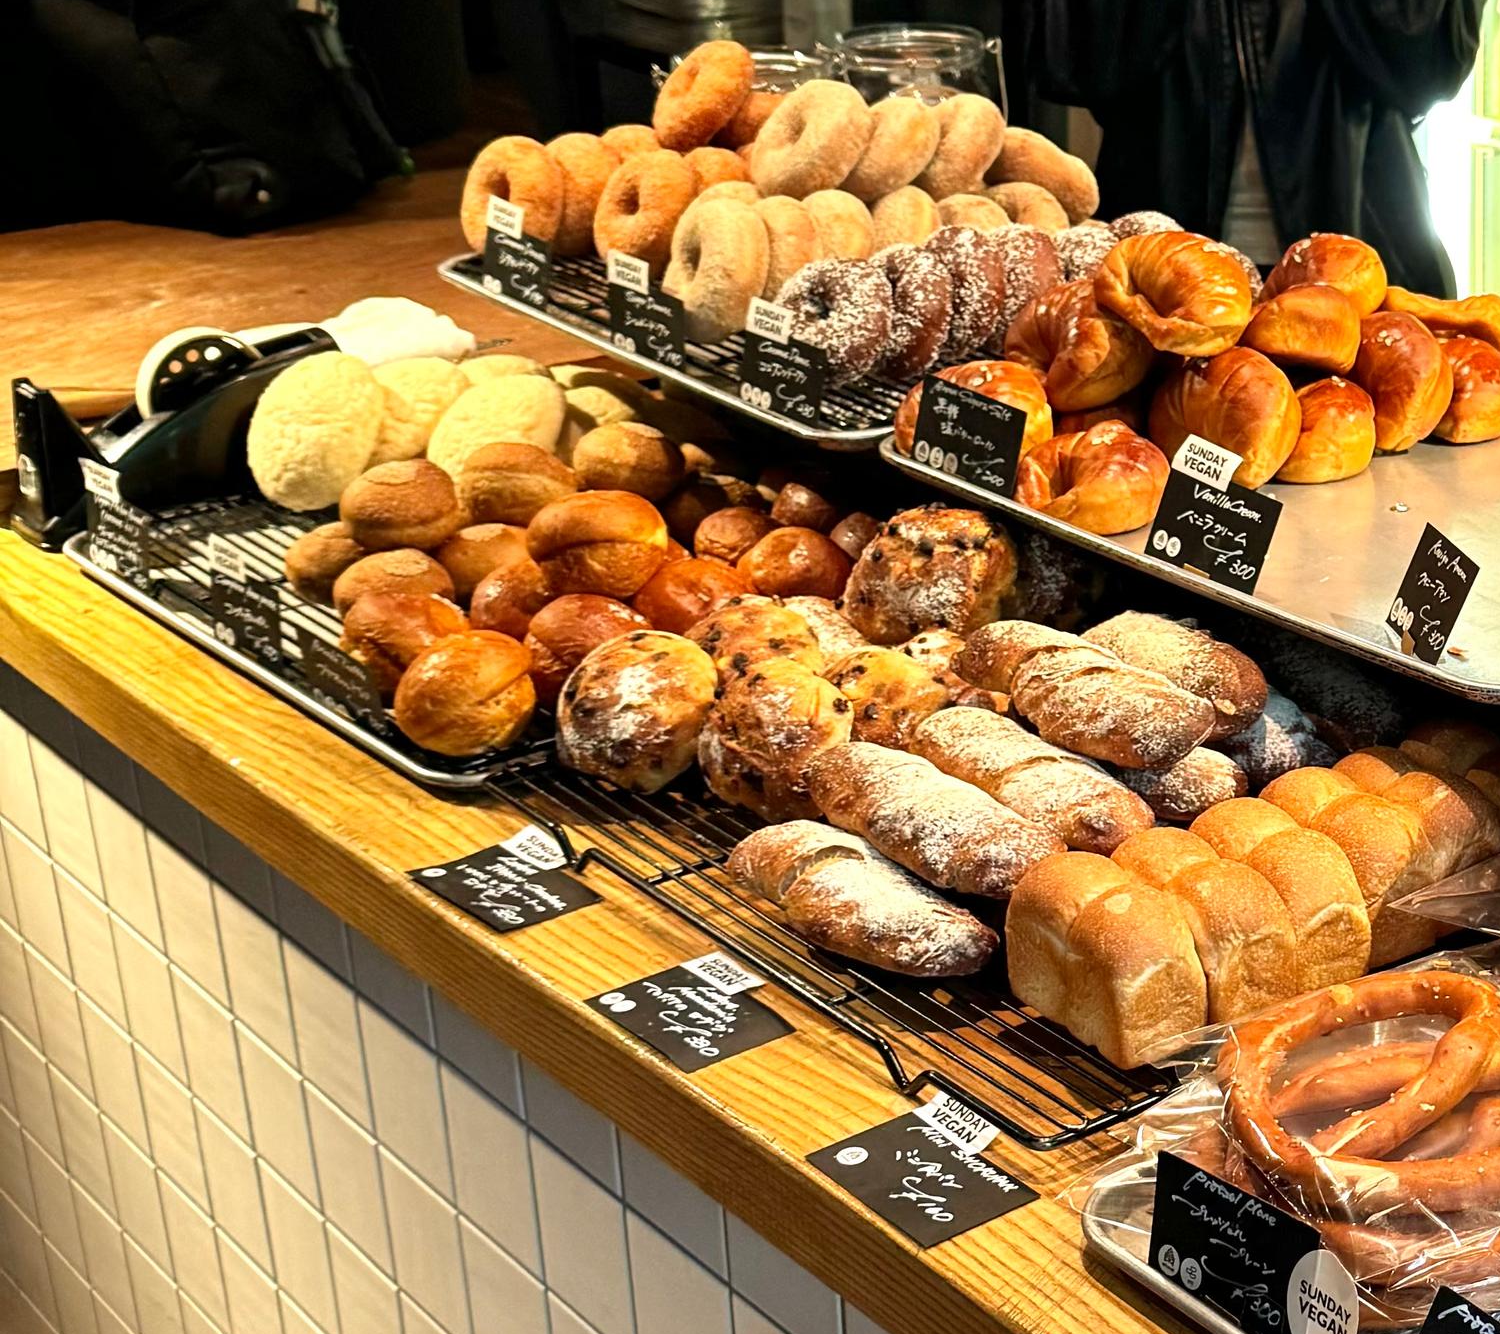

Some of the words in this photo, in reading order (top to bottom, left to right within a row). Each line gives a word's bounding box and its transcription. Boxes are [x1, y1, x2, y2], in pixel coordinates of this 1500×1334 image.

[754, 317, 782, 334] VEGAN
[755, 305, 786, 322] SUNDAY
[1187, 443, 1229, 468] SUNDAY
[1184, 455, 1223, 482] VEGAN
[516, 842, 553, 864] VEGAN
[526, 835, 560, 858] SUNDA
[698, 962, 738, 987] VEGAN
[711, 958, 750, 983] SUNDAY
[932, 1108, 977, 1145] VEGAN
[943, 1097, 990, 1134] SUNDAY
[1299, 1279, 1352, 1325] SUNDAY
